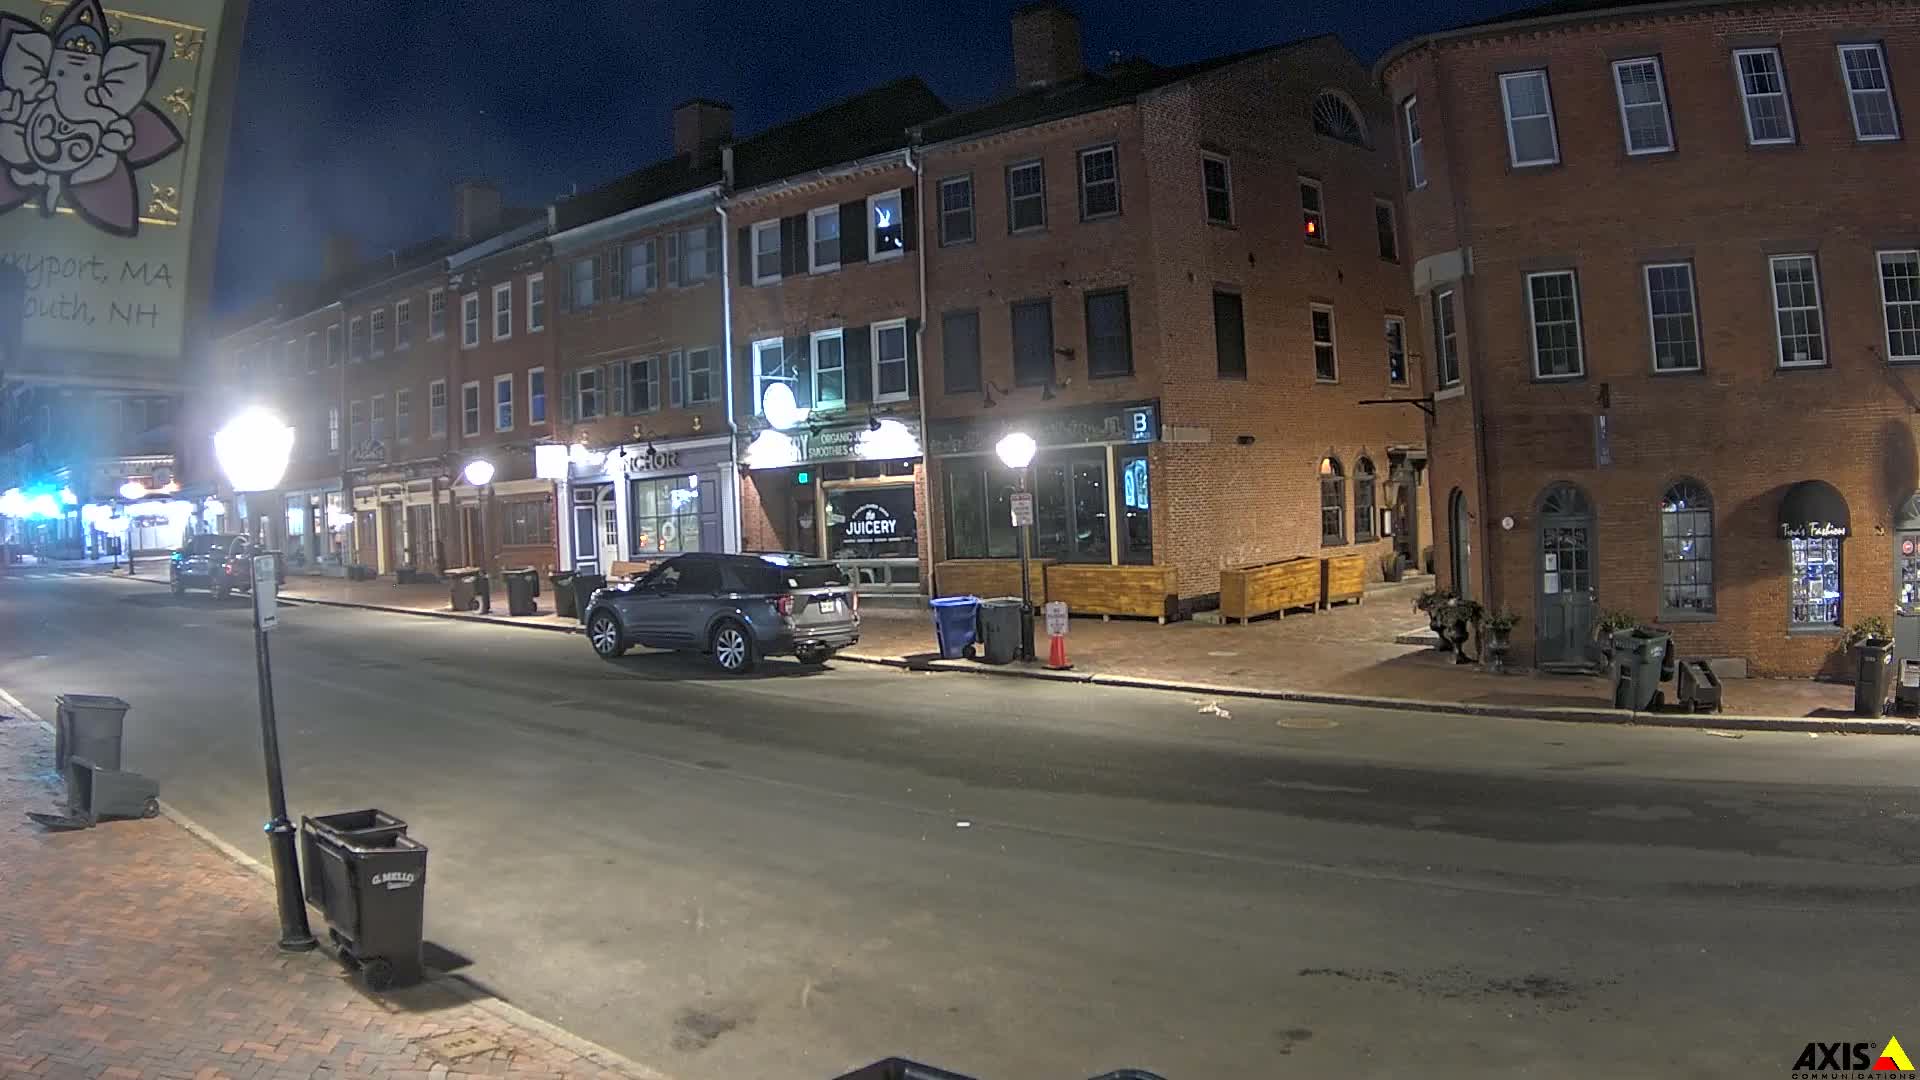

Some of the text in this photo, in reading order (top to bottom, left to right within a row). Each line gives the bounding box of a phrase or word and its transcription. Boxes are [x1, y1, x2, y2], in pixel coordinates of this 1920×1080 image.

[120, 261, 173, 288] MA
[110, 300, 159, 329] NH
[820, 431, 853, 445] ORGANIC
[808, 444, 849, 459] SMOOTHIES
[845, 519, 897, 536] JUICERY
[382, 871, 415, 882] MELLO
